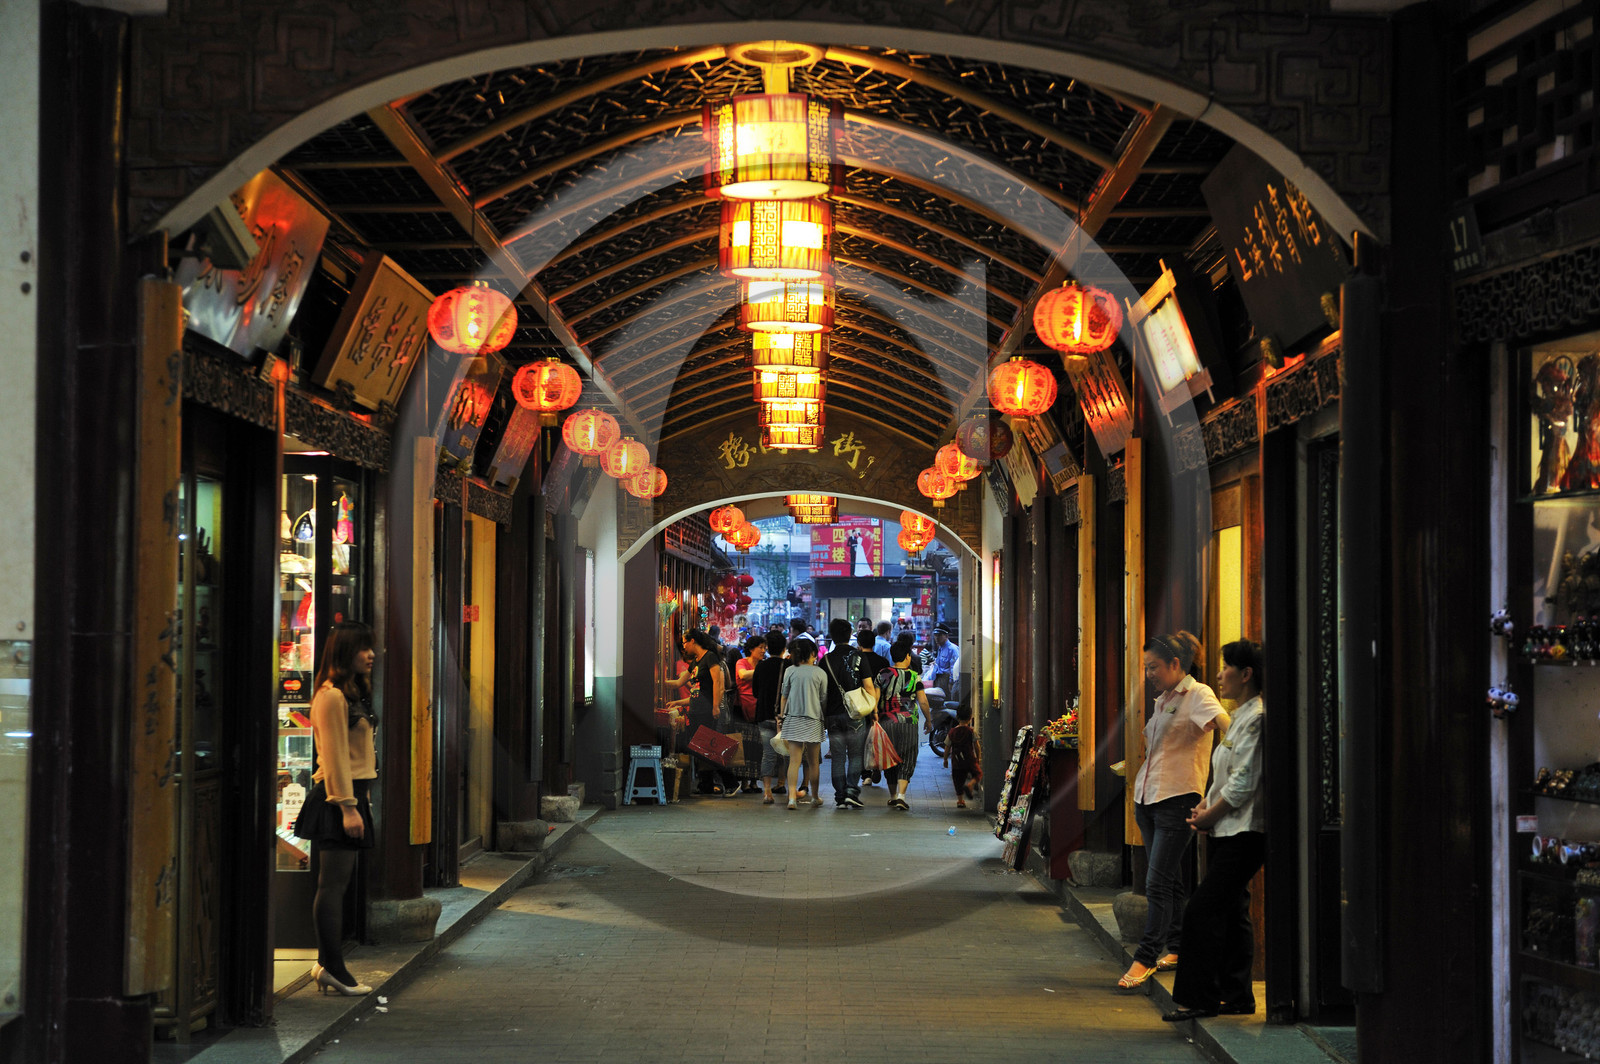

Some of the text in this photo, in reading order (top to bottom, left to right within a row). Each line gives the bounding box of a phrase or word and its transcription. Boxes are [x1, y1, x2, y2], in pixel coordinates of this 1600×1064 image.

[1449, 215, 1468, 253] 17
[718, 431, 866, 470] 豫街
[832, 528, 845, 563] 四楼
